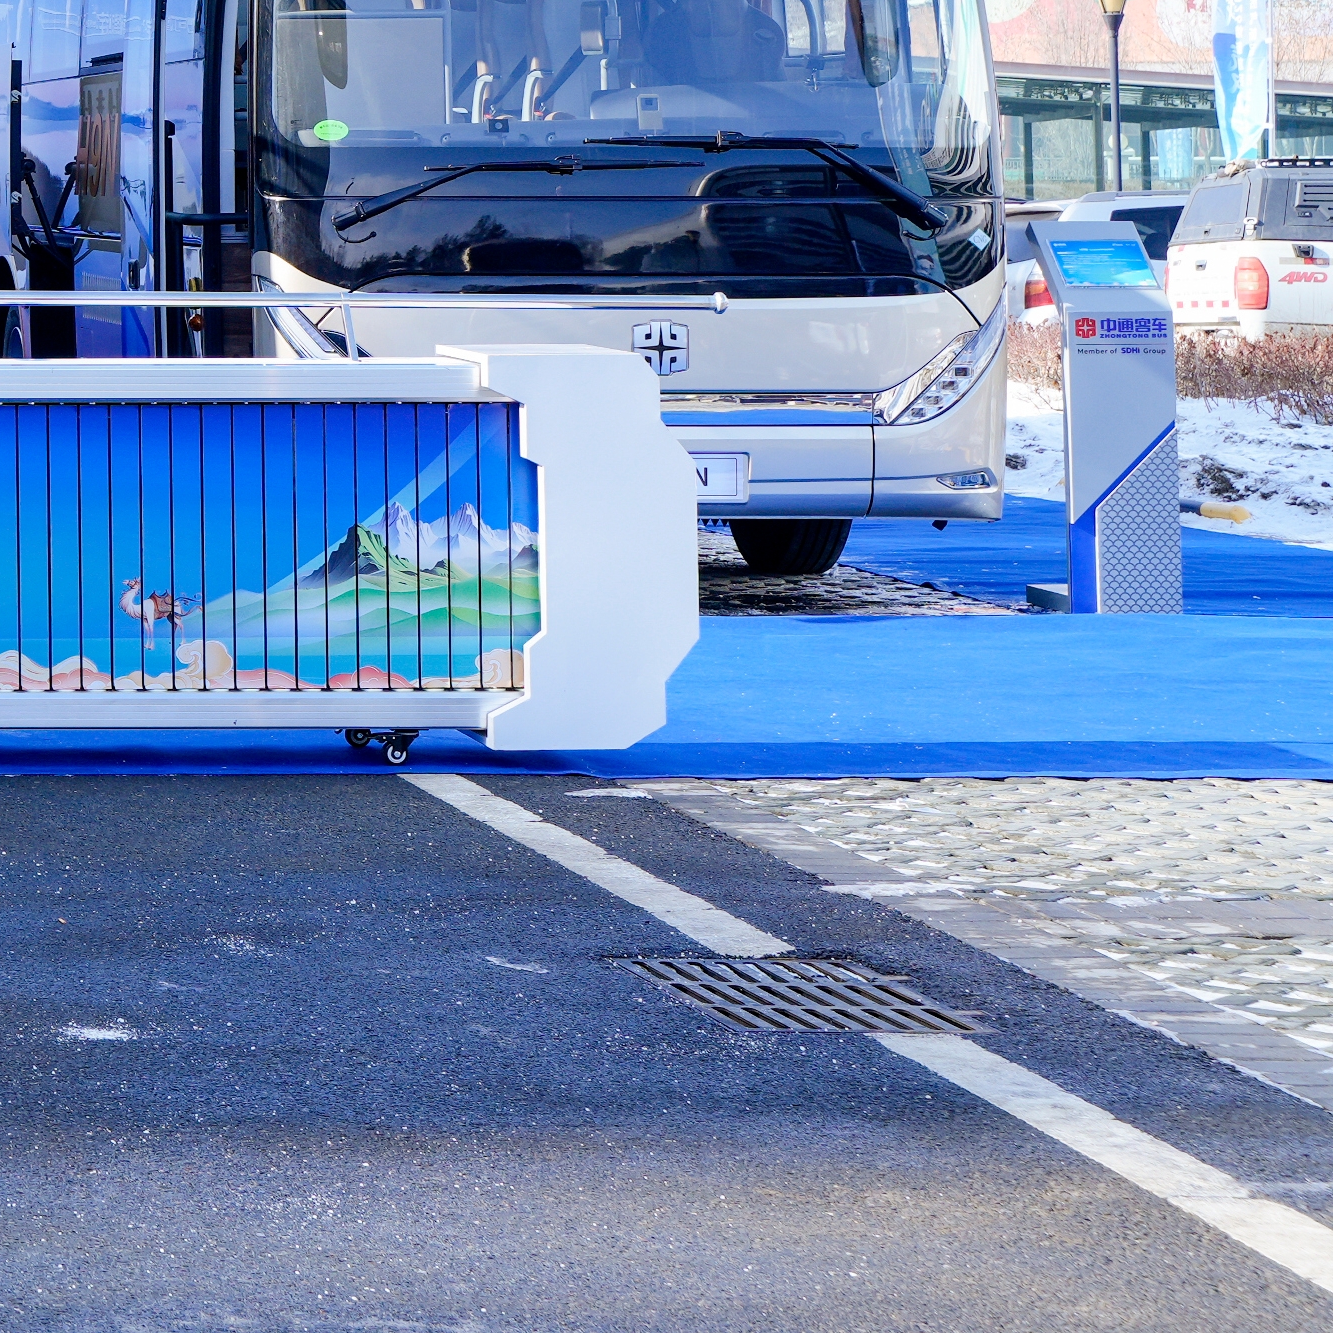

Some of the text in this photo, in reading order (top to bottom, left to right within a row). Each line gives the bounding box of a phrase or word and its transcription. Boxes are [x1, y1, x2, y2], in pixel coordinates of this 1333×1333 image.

[1278, 271, 1328, 284] 4WD
[1100, 318, 1167, 333] 中通客车
